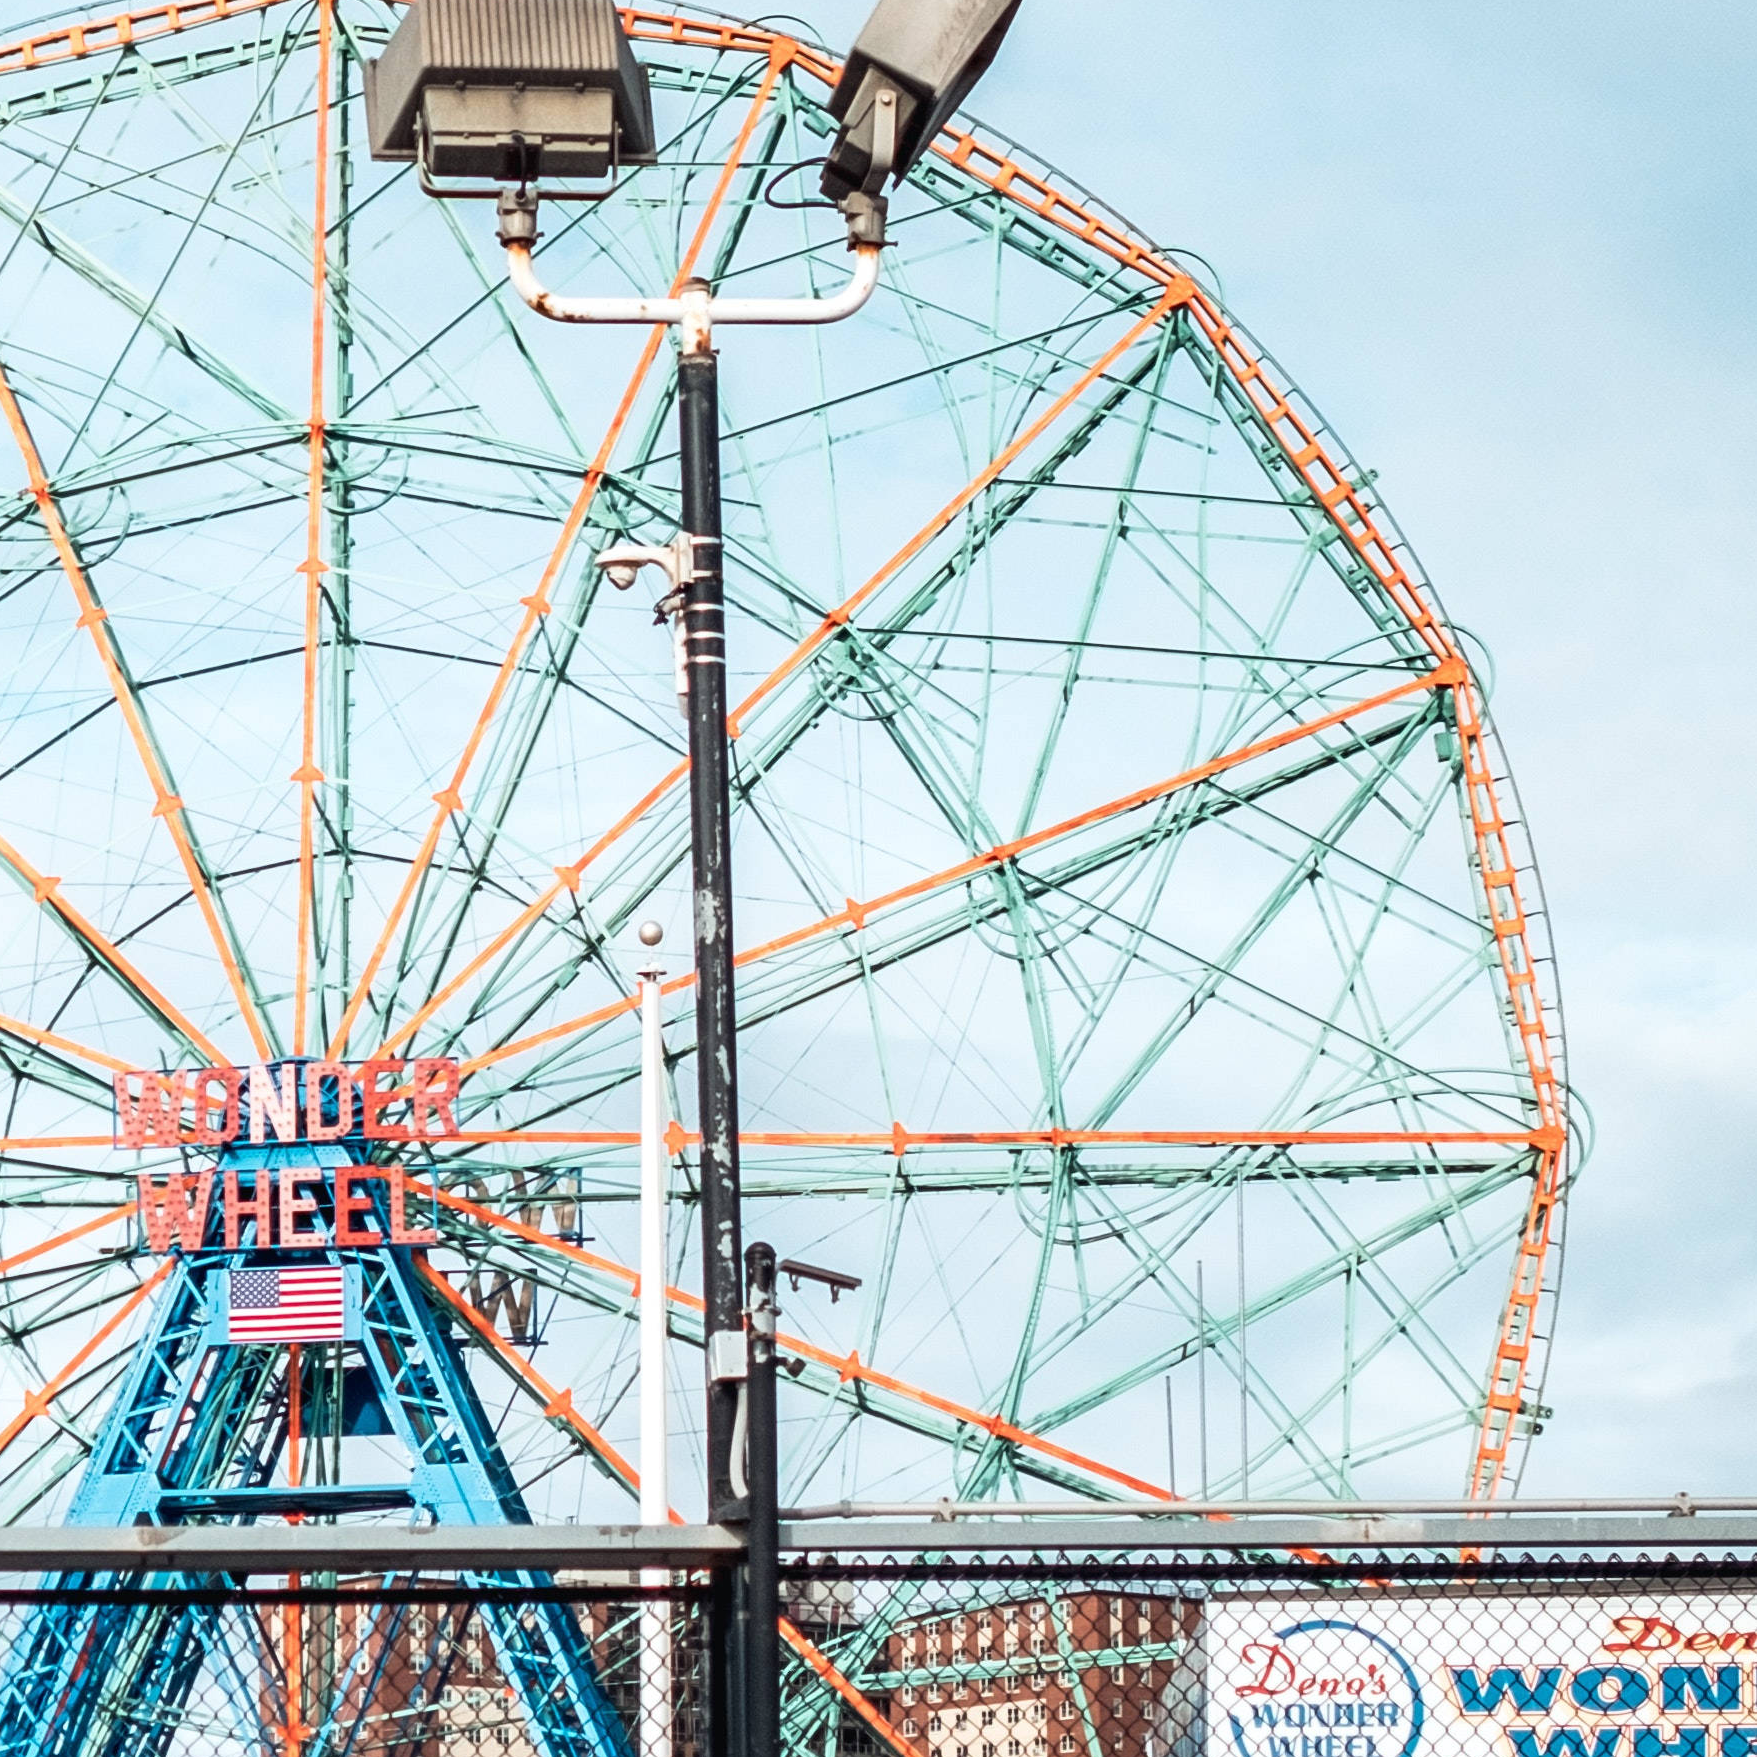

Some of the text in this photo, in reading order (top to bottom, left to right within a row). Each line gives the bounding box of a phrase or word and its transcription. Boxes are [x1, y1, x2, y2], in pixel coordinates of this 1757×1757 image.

[113, 1057, 460, 1150] WONDER
[138, 1164, 437, 1253] WHEEL
[1235, 1643, 1386, 1697] Deno's
[1445, 1662, 1757, 1715] WON
[1251, 1703, 1401, 1728] WONDER
